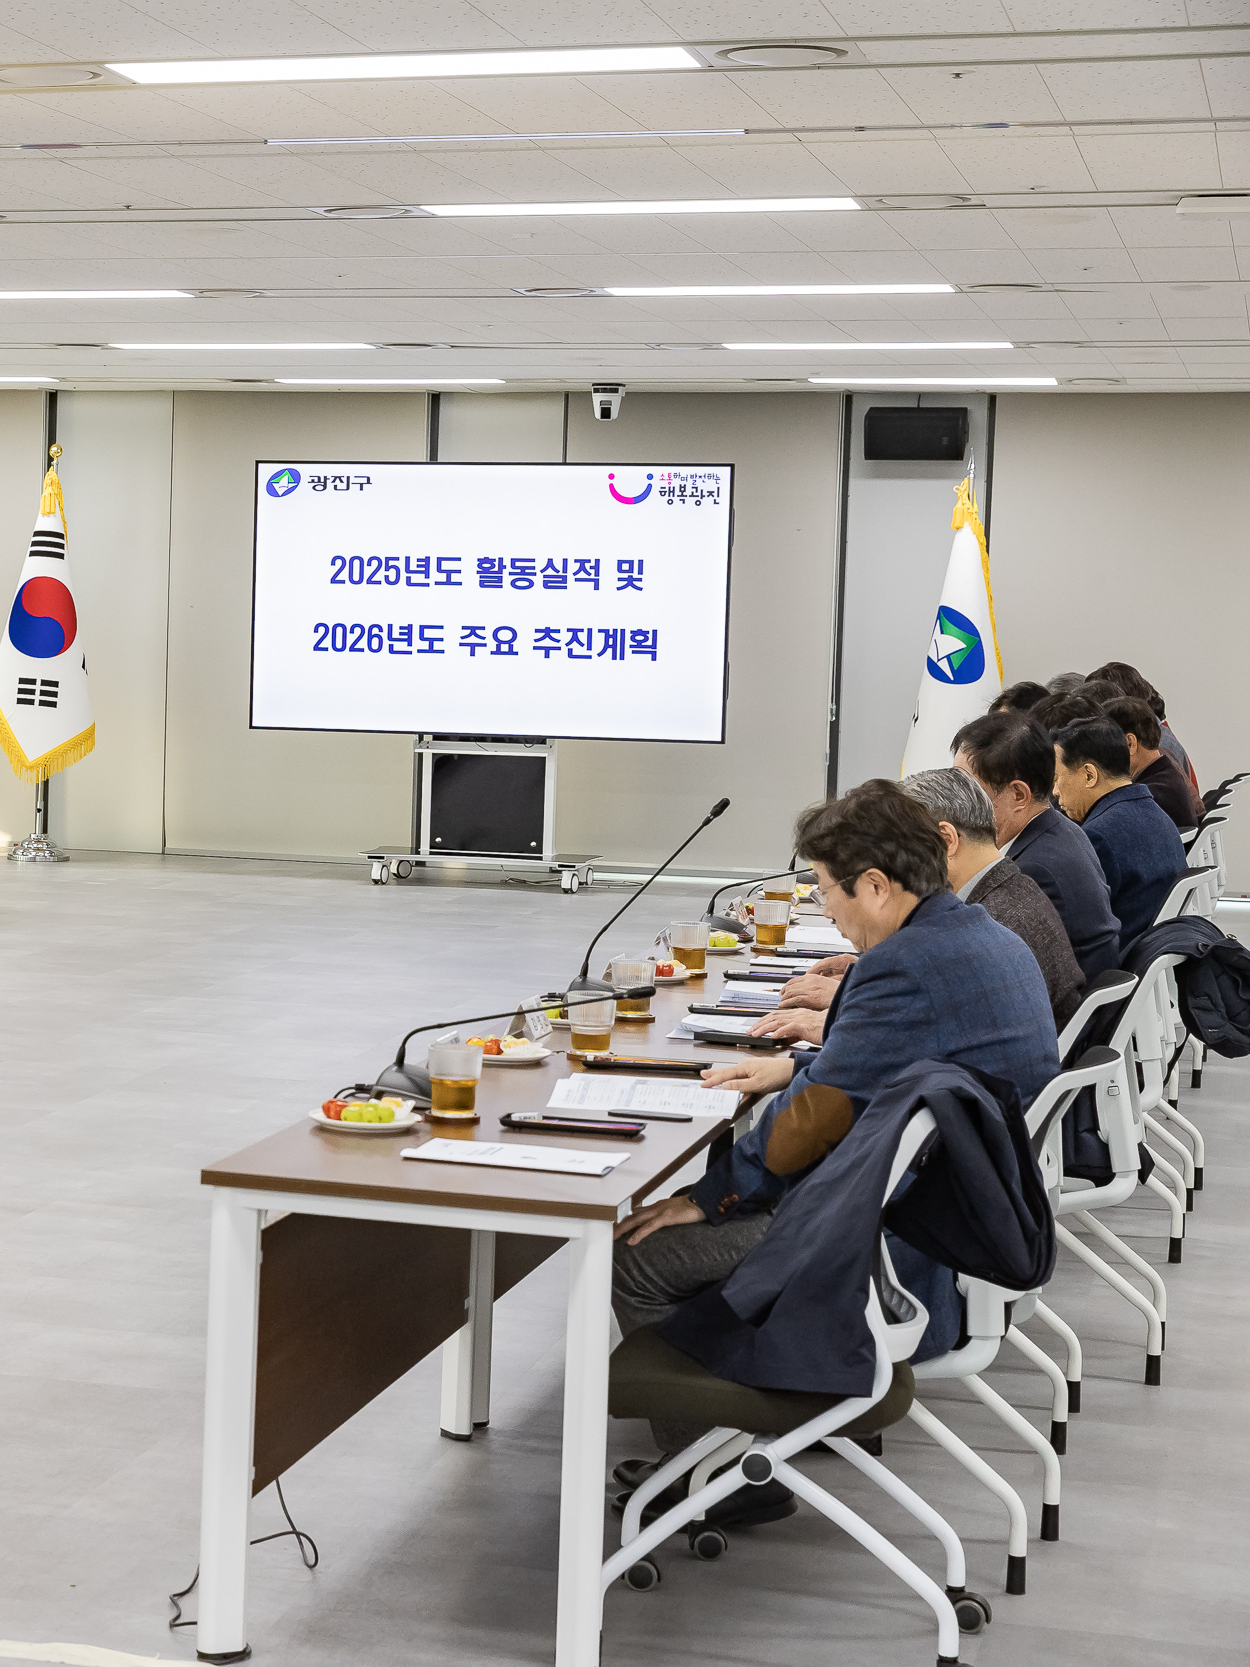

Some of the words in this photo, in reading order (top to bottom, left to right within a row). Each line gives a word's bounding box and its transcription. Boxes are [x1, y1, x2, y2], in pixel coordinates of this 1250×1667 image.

[307, 475, 372, 492] 광진구
[659, 472, 689, 485] 소통하며
[689, 472, 721, 485] 발전하는
[658, 484, 720, 506] 행복광진
[330, 555, 463, 587] 2025년도
[476, 556, 601, 591] 활동실적
[616, 559, 644, 591] 및
[313, 622, 445, 655] 2026년도
[458, 625, 519, 657] 주요
[532, 627, 659, 662] 추진계획
